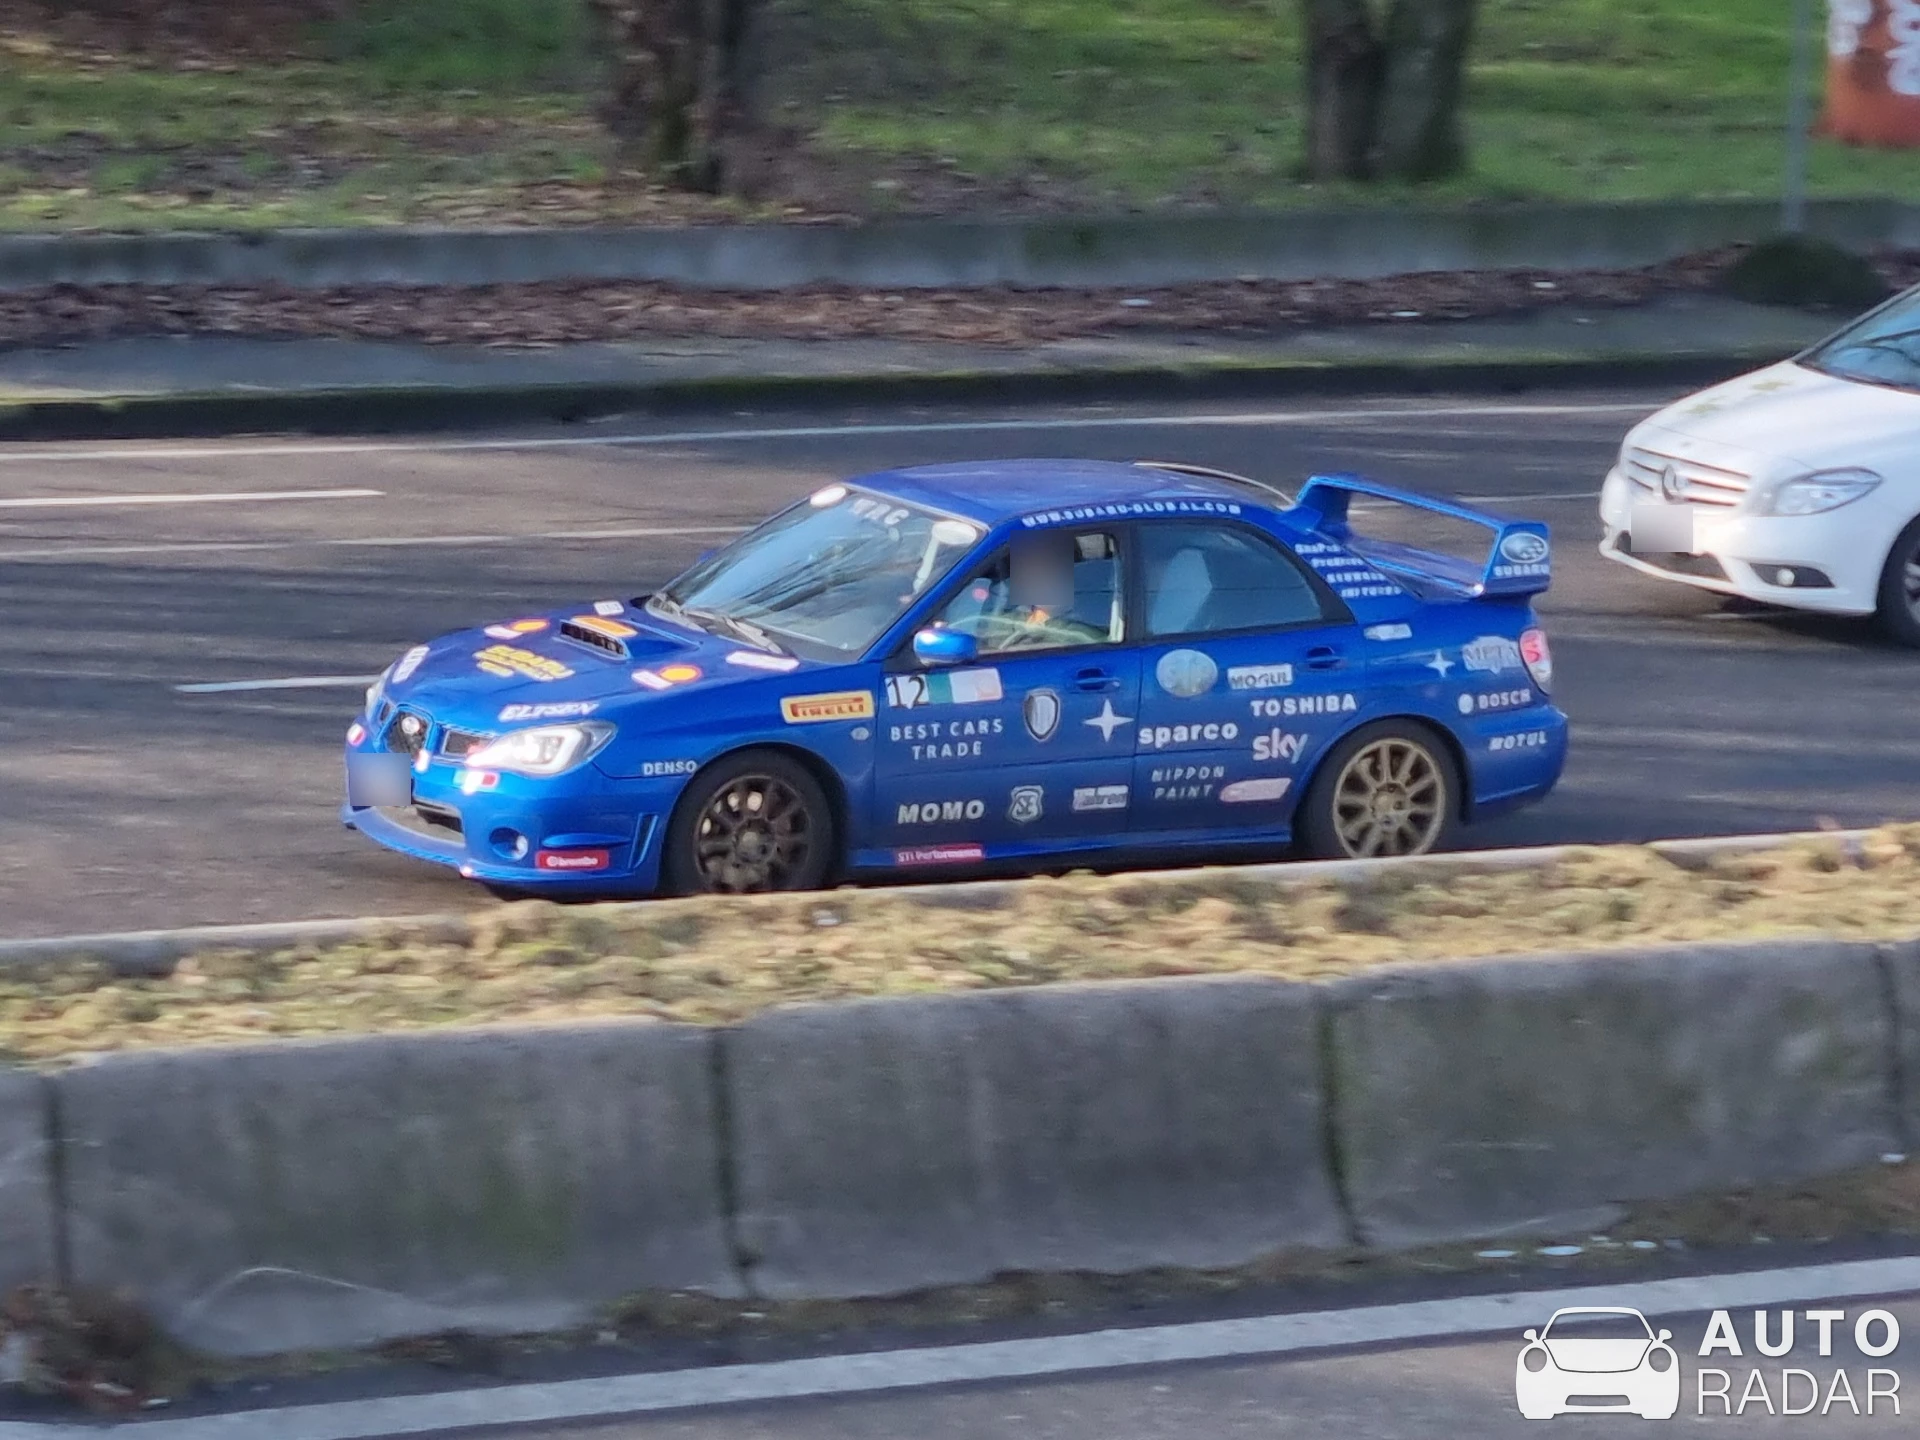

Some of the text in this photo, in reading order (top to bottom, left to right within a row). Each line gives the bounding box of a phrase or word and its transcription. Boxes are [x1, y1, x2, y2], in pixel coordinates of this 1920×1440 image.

[1231, 671, 1289, 687] MOGUL
[885, 675, 929, 708] 12
[1251, 693, 1357, 717] TOSHIBA
[890, 718, 1004, 741] BEST CARS
[1138, 722, 1239, 749] sparco
[911, 741, 983, 760] TRADE
[1252, 727, 1309, 764] sky
[642, 760, 697, 776] DENSO
[897, 800, 985, 824] MOMO
